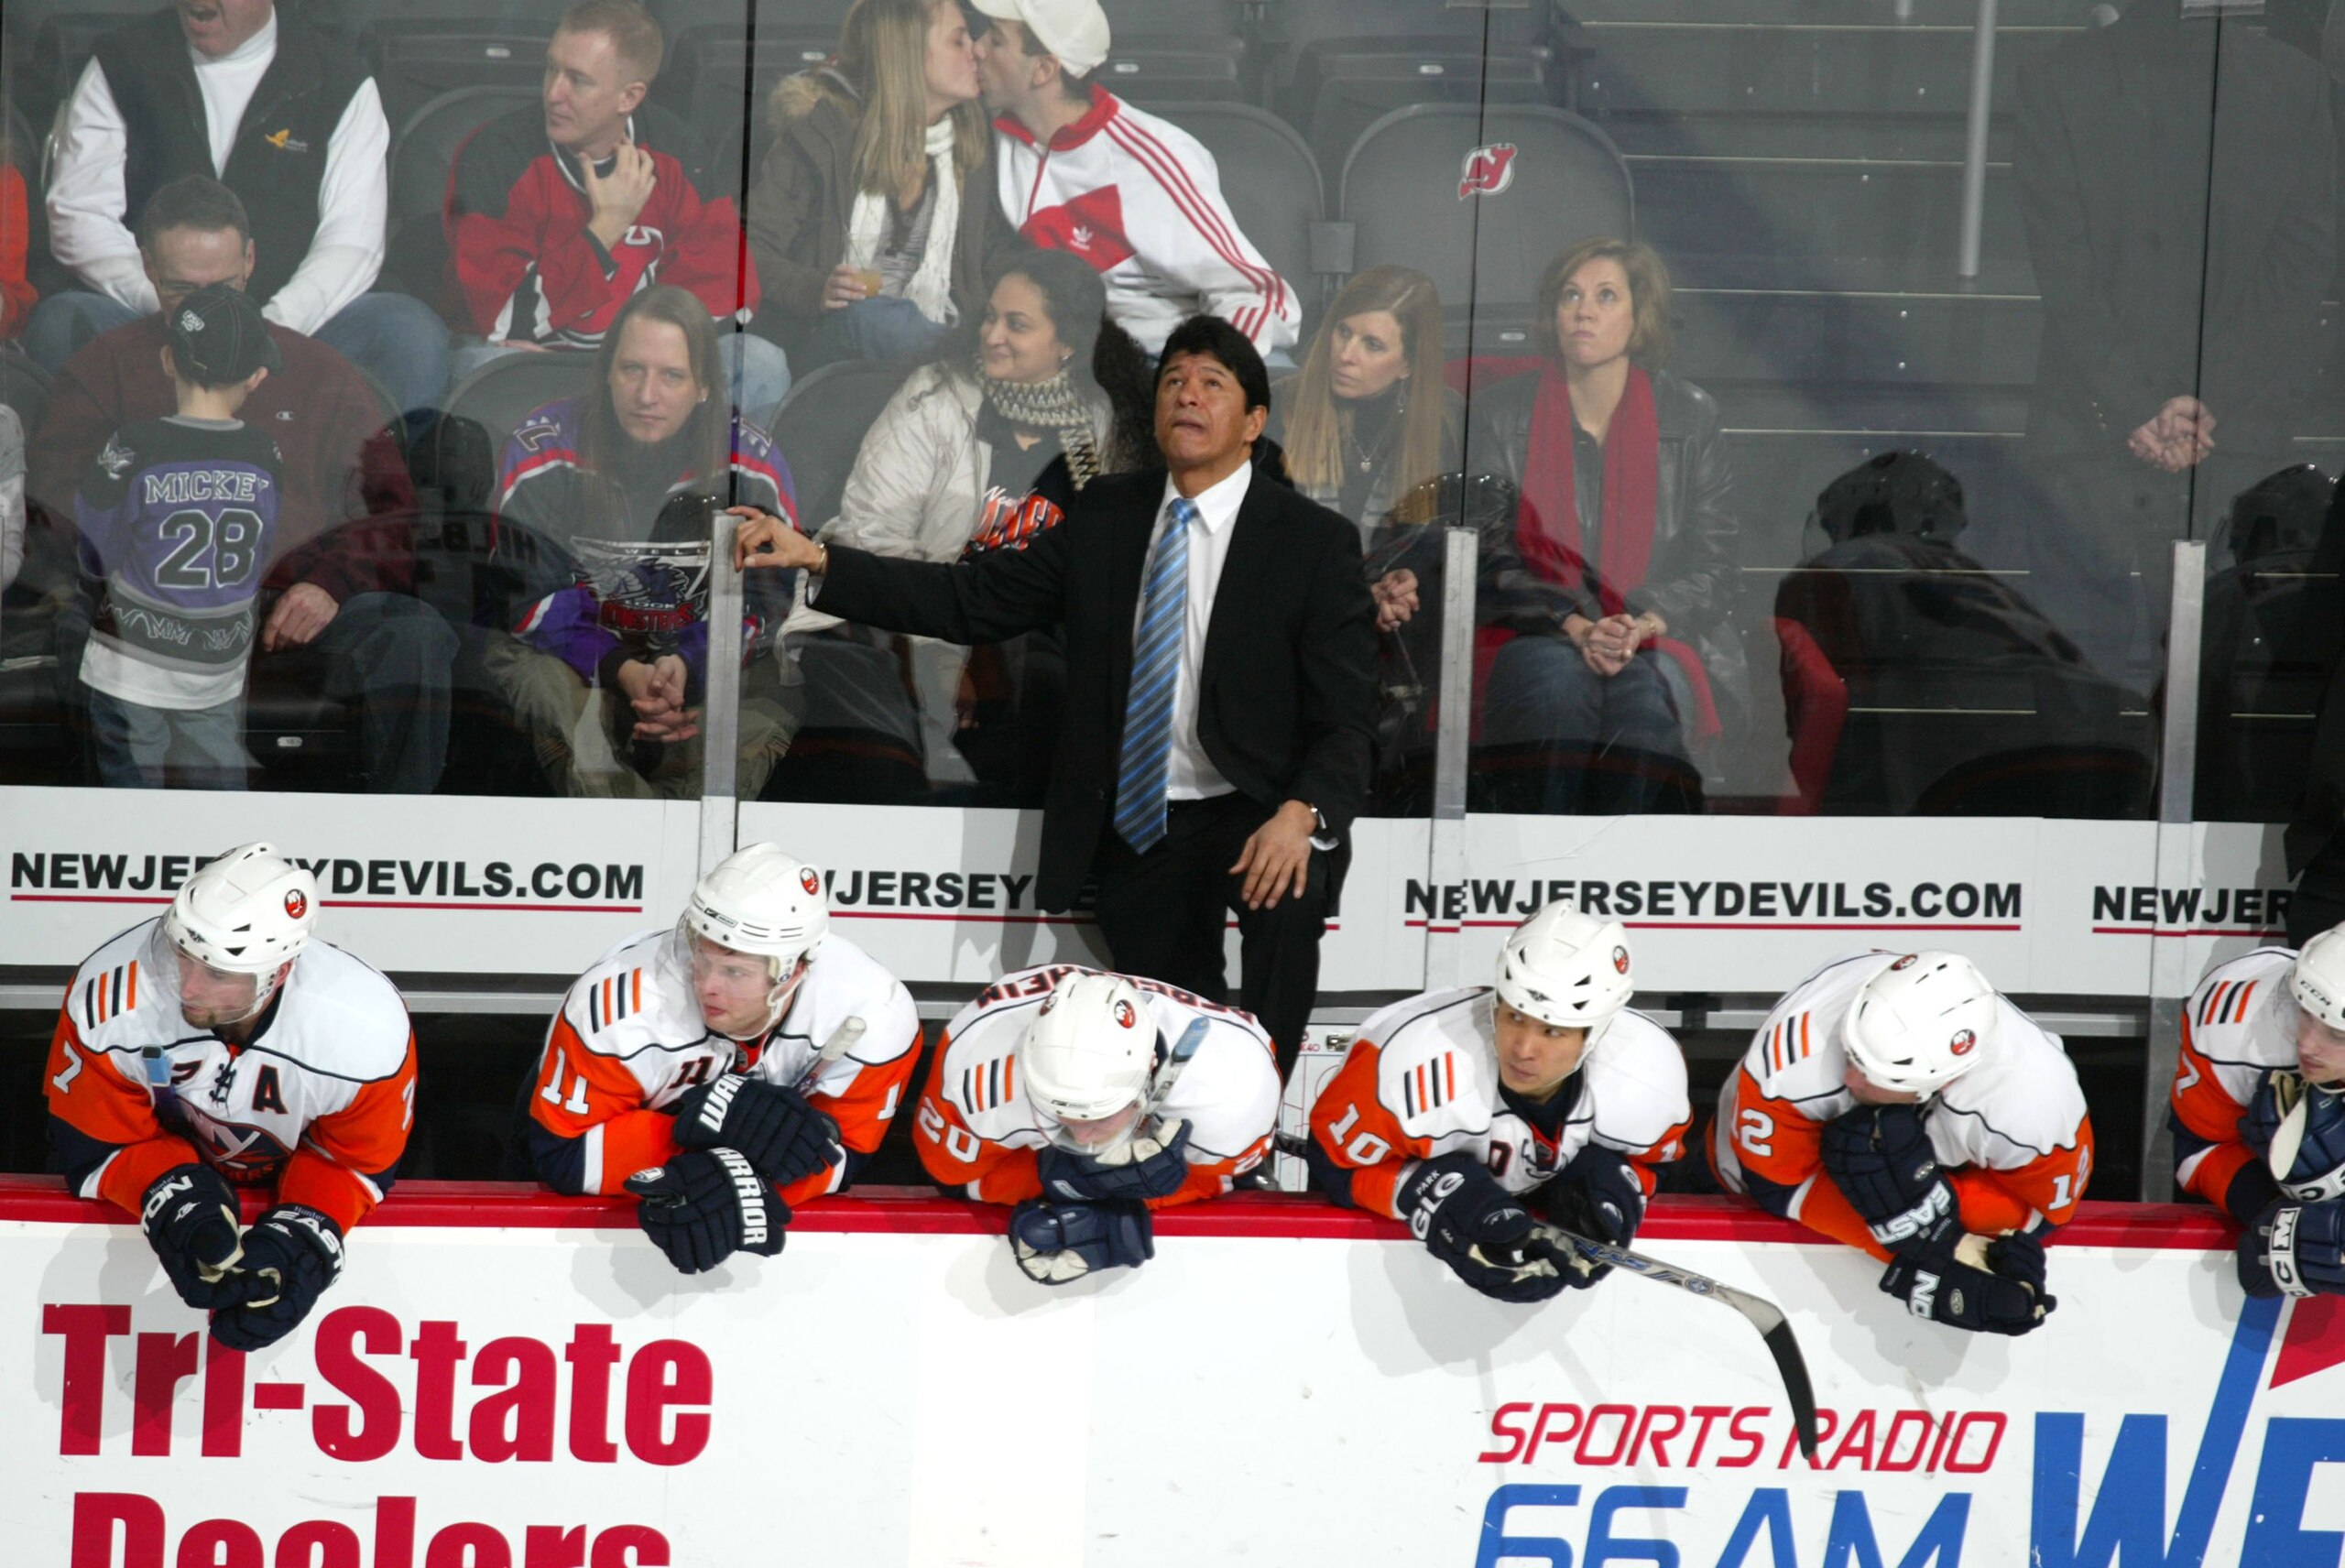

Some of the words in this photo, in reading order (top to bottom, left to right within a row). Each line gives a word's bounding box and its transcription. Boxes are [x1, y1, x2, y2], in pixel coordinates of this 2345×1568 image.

[146, 471, 268, 504] MICKE
[155, 507, 264, 589] 28
[10, 853, 643, 900] NEWJEYDEVILS.COM
[2299, 979, 2332, 1007] CCM
[52, 1040, 83, 1094] 7
[252, 1063, 289, 1115] A
[540, 1046, 589, 1116] 11
[670, 1055, 714, 1090] 11
[918, 1096, 981, 1164] 20
[1327, 1103, 1391, 1166] 10
[1415, 1170, 1441, 1196] PARK
[293, 1205, 327, 1223] Hunter
[42, 1304, 713, 1465] Tri-State
[1478, 1402, 1771, 1467] SPORTS
[1778, 1408, 2008, 1474] RADIO
